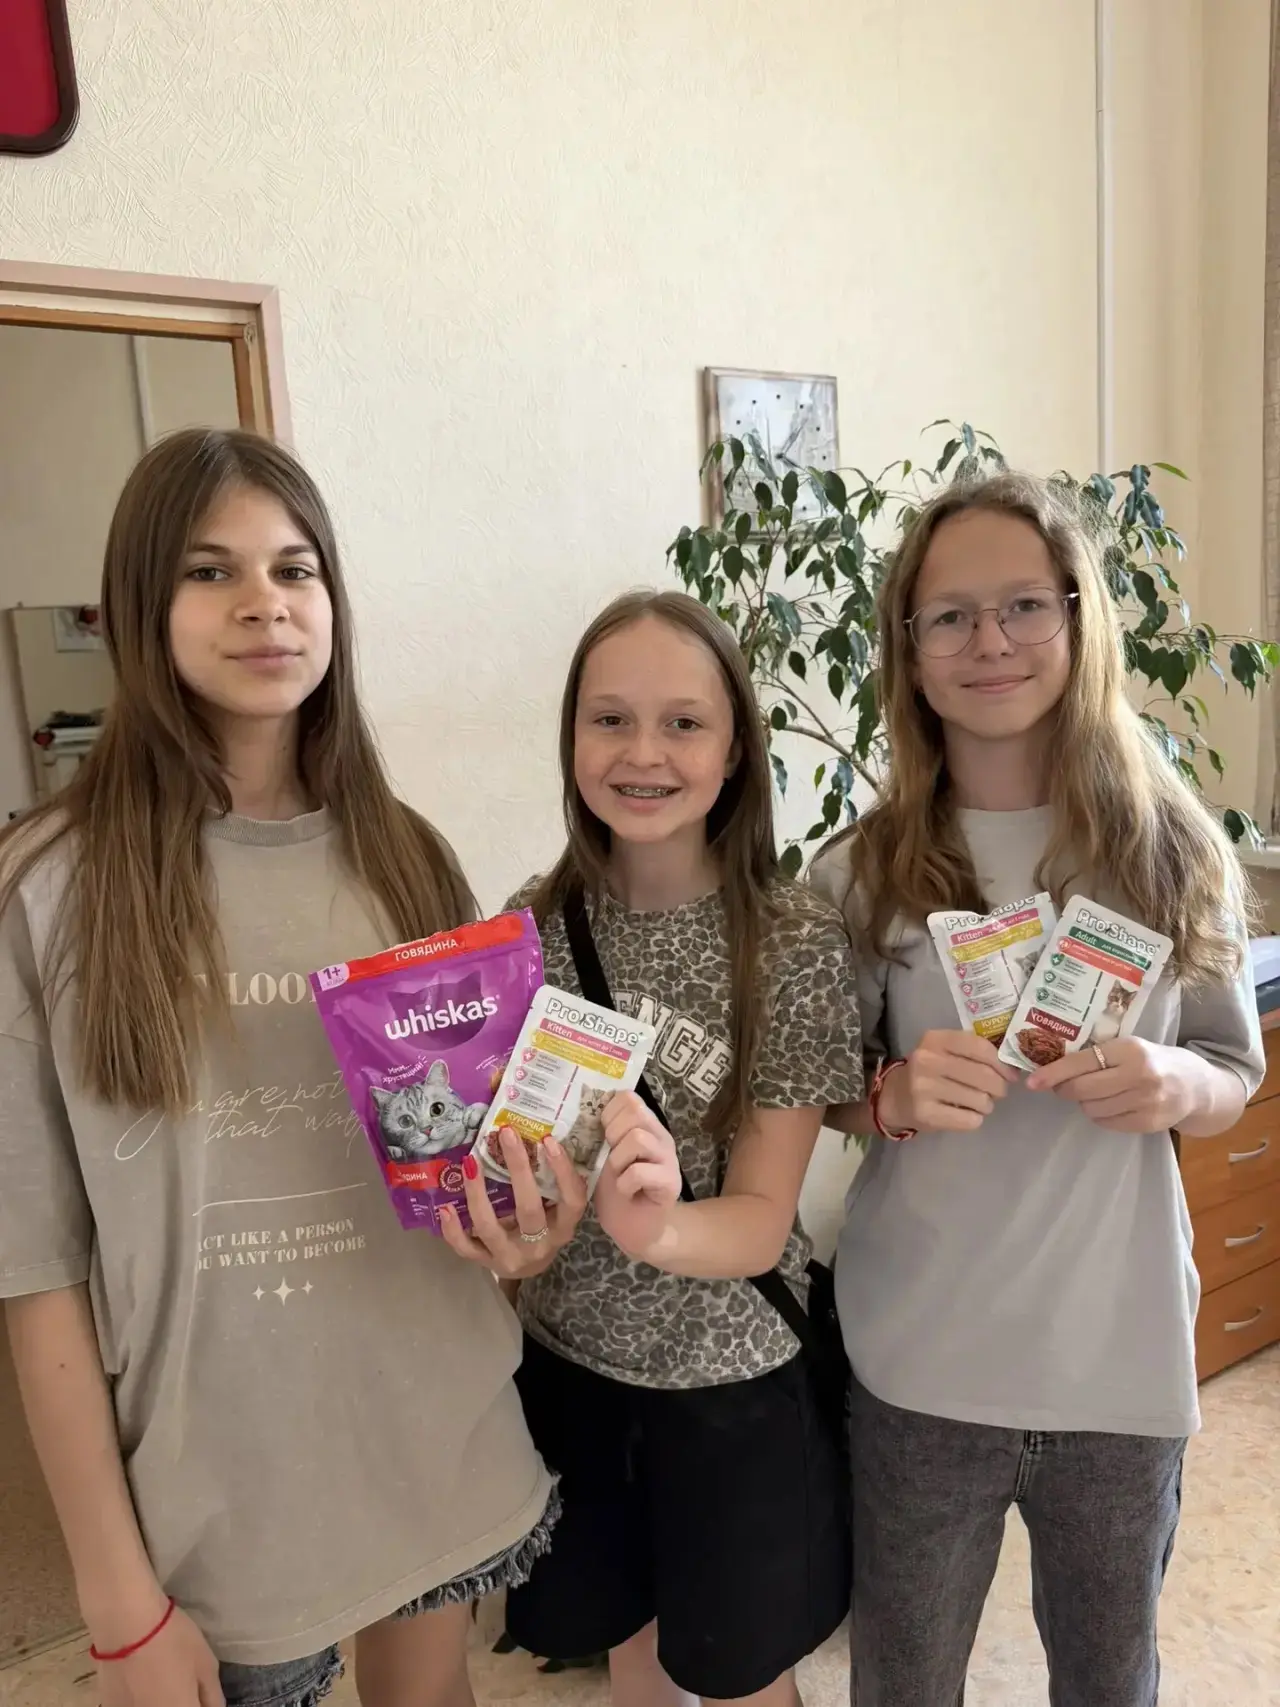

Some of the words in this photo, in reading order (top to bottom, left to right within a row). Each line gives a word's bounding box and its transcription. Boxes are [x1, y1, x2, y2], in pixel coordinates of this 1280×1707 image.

[956, 930, 984, 943] Kitten
[1075, 930, 1098, 946] Adult
[395, 938, 459, 962] ГОВЯДИНА
[322, 966, 342, 981] 1+
[224, 971, 317, 1005] LOO
[384, 996, 498, 1040] whiskas
[1032, 1012, 1076, 1037] ГОВЯДИНА
[547, 1022, 573, 1039] Kitten
[204, 1098, 303, 1144] that
[507, 1111, 545, 1132] КУРОЧКА
[231, 1230, 272, 1246] LIKE
[277, 1230, 289, 1243] A
[295, 1217, 355, 1241] PERSON
[219, 1249, 269, 1267] WANT
[274, 1248, 298, 1263] TO
[303, 1235, 368, 1260] BECOME
